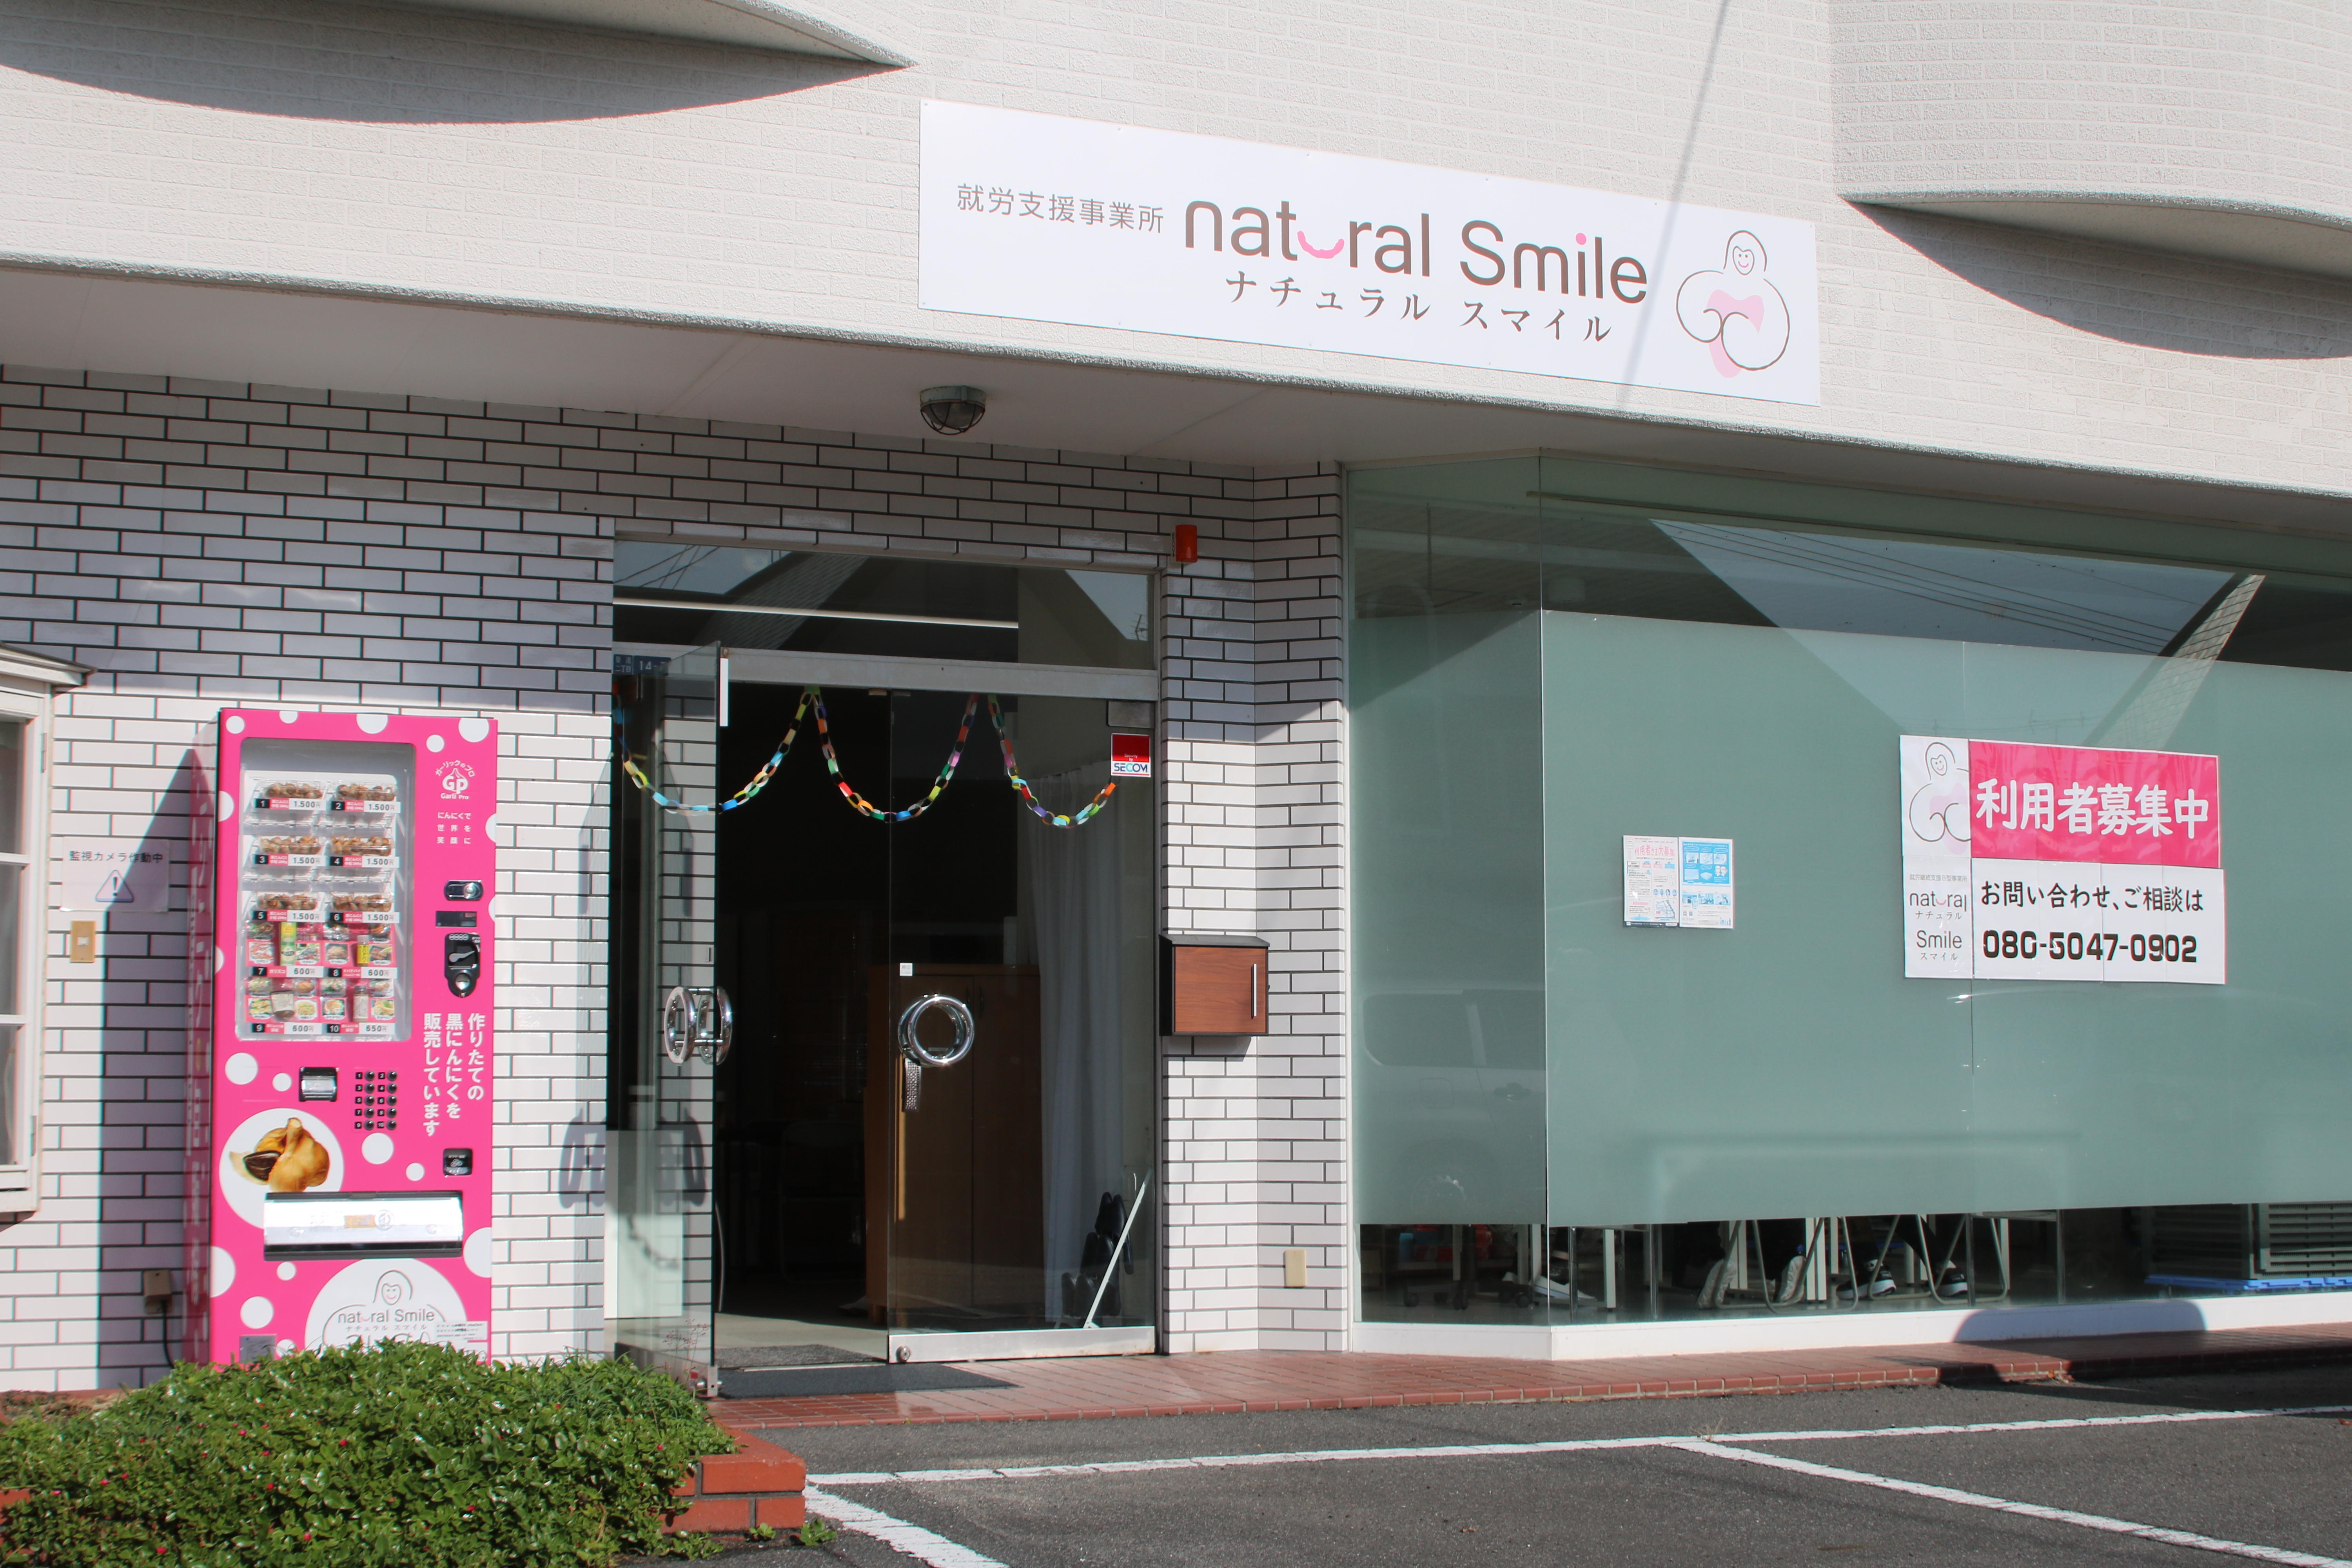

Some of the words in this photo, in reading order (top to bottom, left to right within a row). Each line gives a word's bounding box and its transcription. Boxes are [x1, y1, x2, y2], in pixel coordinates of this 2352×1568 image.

[957, 183, 1163, 234] 就労支援事業所
[1185, 200, 1430, 277] natural
[1460, 219, 1647, 304] Smile
[1226, 270, 1431, 321] ナチュラル
[1459, 300, 1612, 342] スマイル
[639, 661, 666, 671] 14-
[435, 760, 475, 777] ガーリックのプロ
[1114, 763, 1148, 773] SECOM
[1976, 778, 2209, 839] 利用者募集中
[69, 850, 163, 863] 監視カメラ作動中
[1981, 880, 2204, 912] お問い合わせ、ご相談は
[1915, 910, 1962, 920] ナチュラル
[1916, 929, 1962, 949] Smile
[1983, 930, 2197, 963] 080-5047-0902
[1920, 952, 1958, 961] スマイル
[445, 1013, 463, 1119] 黒にんにくを
[467, 1013, 485, 1101] 作りたての
[423, 1013, 442, 1137] 販売しています
[394, 1308, 434, 1322] Smile
